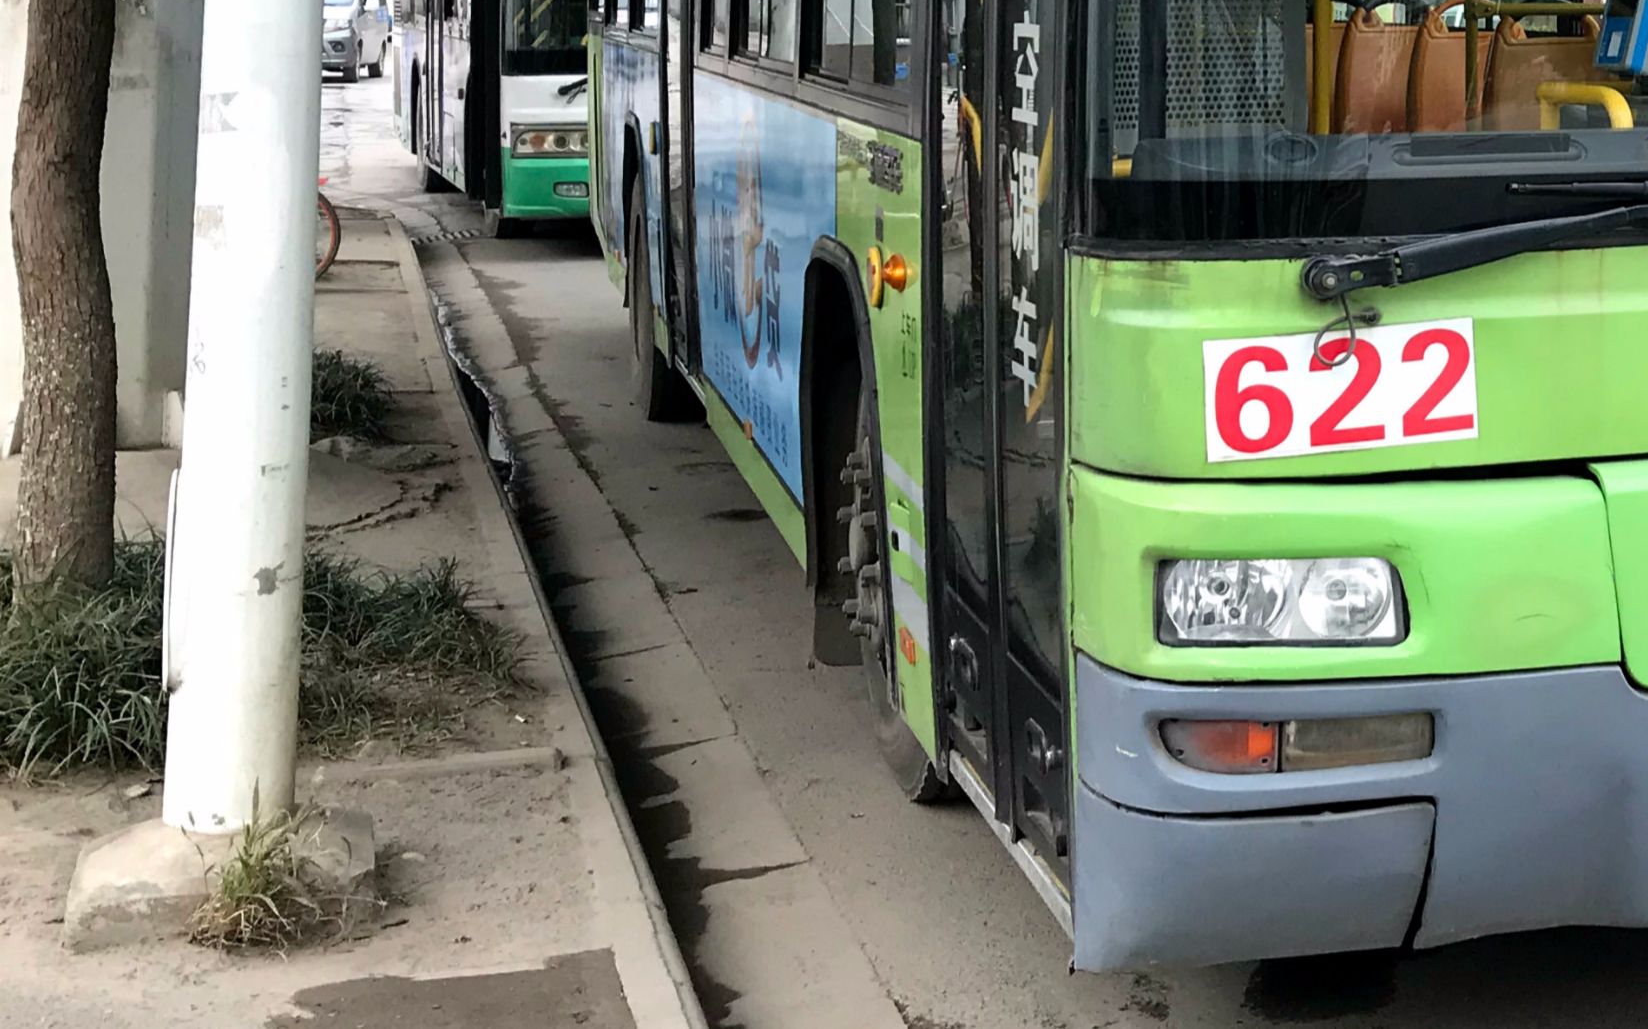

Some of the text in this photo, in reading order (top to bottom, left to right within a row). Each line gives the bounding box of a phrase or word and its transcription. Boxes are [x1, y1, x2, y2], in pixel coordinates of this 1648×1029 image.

[1011, 10, 1041, 408] 空调车
[1214, 328, 1475, 454] 622
